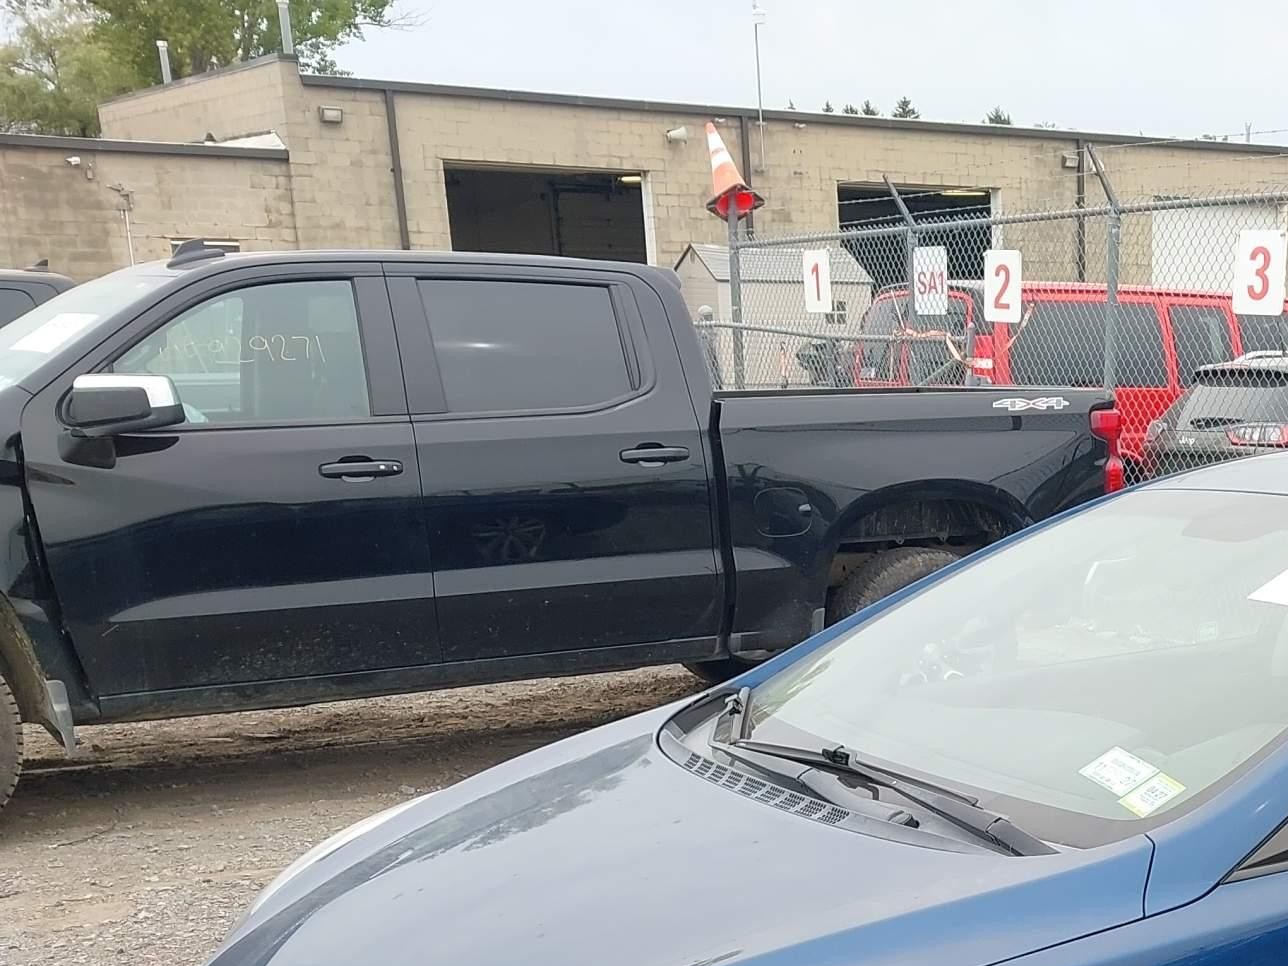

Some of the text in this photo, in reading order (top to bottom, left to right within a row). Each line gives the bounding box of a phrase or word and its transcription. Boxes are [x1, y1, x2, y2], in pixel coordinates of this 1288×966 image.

[810, 261, 821, 302] 1
[917, 270, 945, 295] SA1
[993, 263, 1011, 310] 2
[1247, 245, 1271, 301] 3
